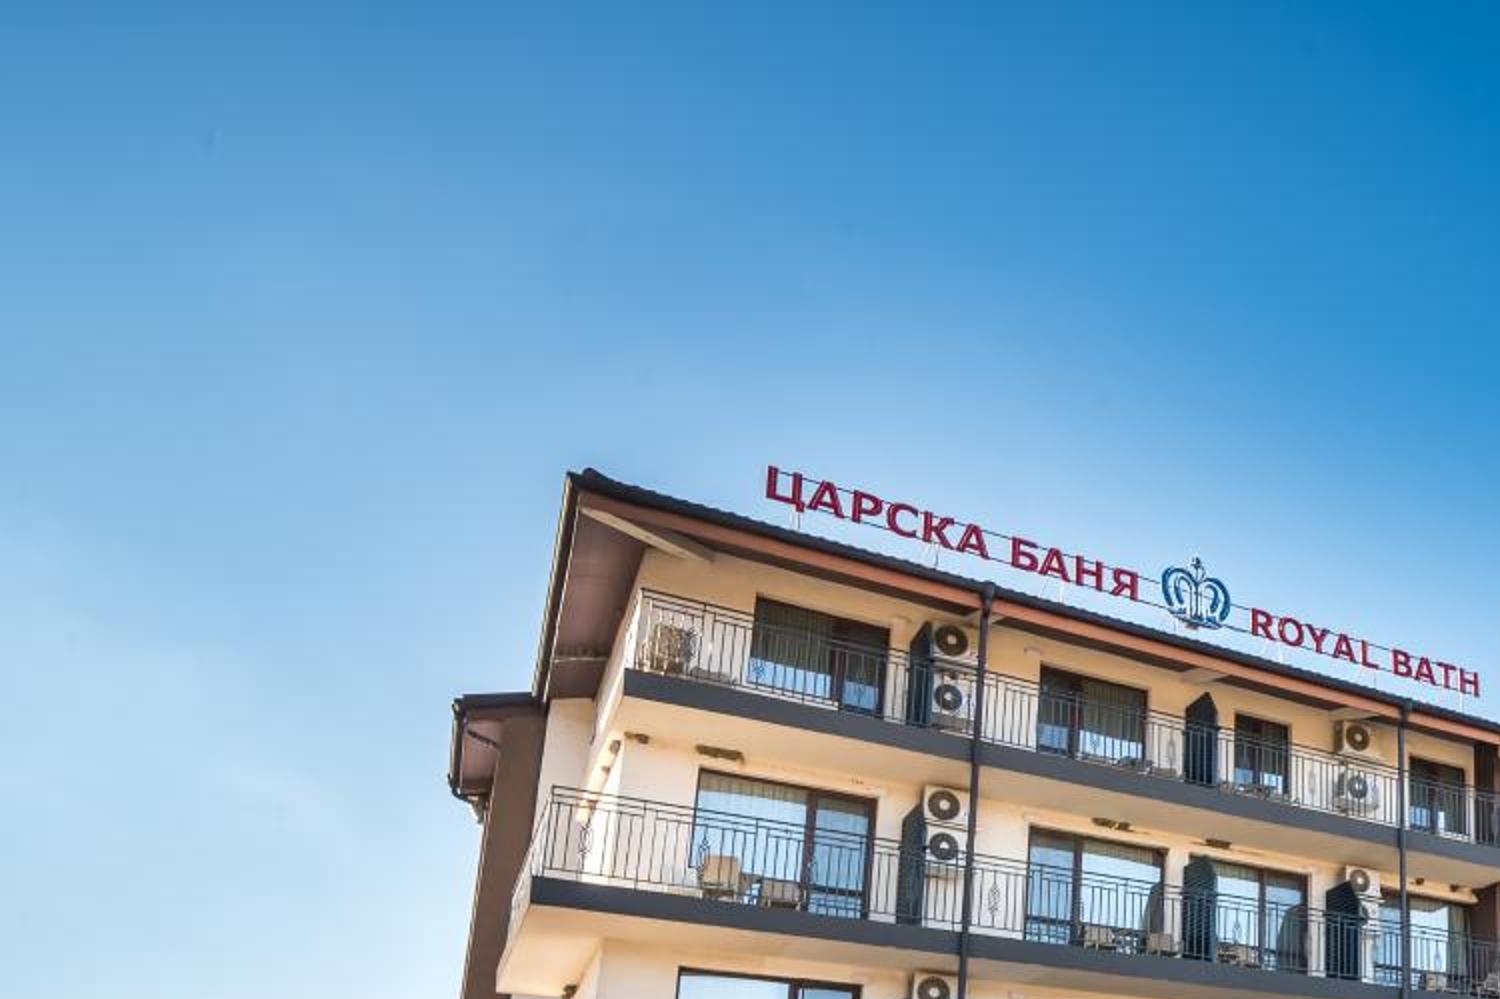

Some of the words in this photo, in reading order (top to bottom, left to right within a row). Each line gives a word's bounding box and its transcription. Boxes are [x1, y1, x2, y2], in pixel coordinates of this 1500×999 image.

[765, 466, 989, 559] ЦАРСКА
[1010, 537, 1140, 601] БАНЯ
[1251, 608, 1380, 669] ROYAL
[1391, 650, 1480, 697] BATH
